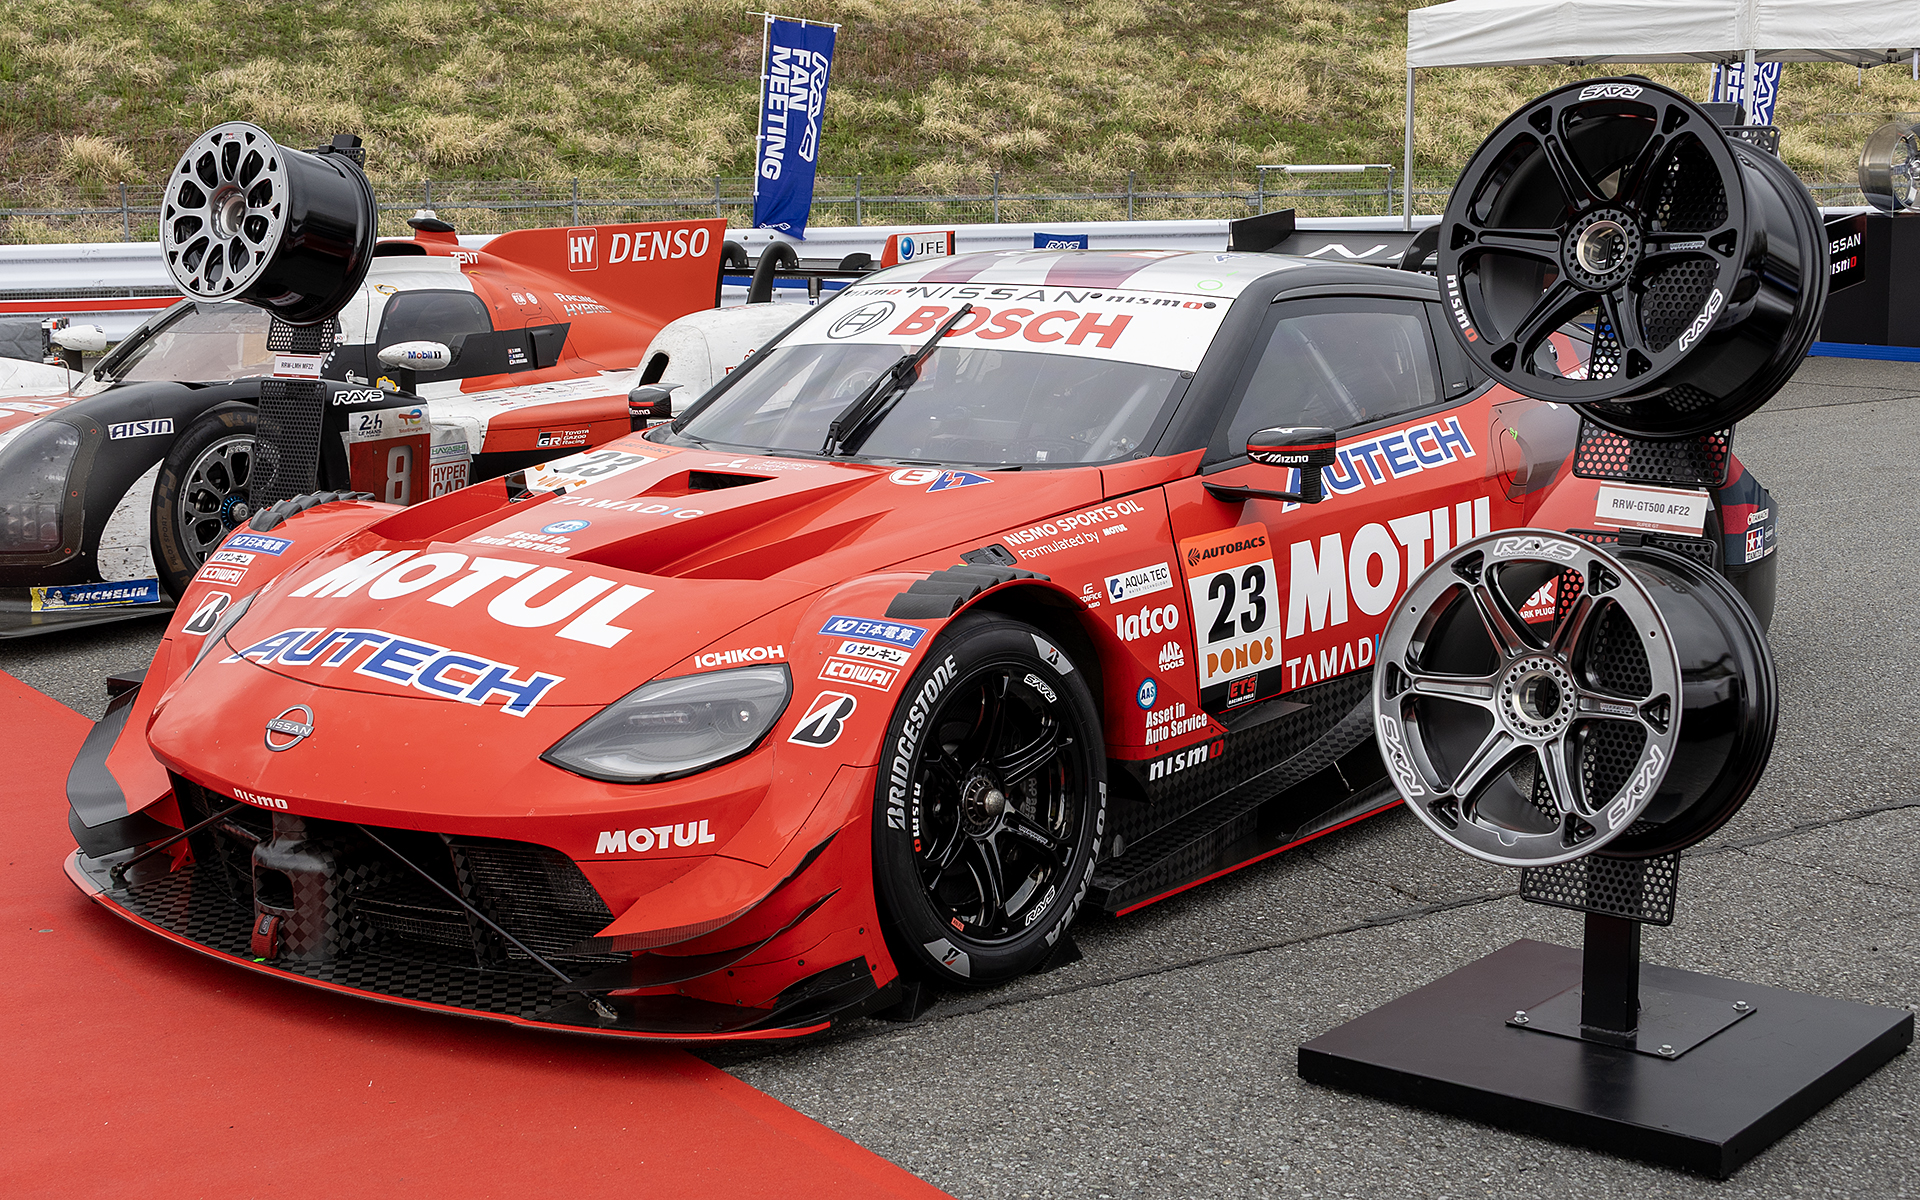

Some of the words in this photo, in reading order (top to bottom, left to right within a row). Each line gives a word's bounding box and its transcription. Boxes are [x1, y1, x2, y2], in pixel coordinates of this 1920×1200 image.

[788, 48, 812, 112] FAN
[1579, 83, 1643, 100] RAYS
[761, 45, 792, 181] MEETING
[799, 51, 829, 163] RAYS
[569, 236, 596, 264] HY
[608, 227, 710, 264] DENSO
[916, 241, 945, 256] JFE
[1830, 232, 1861, 255] ISSAN
[450, 252, 479, 264] ZENT
[907, 286, 1091, 304] NISSAN
[1105, 295, 1203, 310] nismo
[1446, 274, 1479, 343] nismo
[888, 305, 1134, 350] BOSCH
[1678, 288, 1723, 352] RAYS
[407, 351, 433, 360] Mobil
[333, 389, 385, 406] RAYS
[431, 444, 466, 455] HAYASHI
[538, 437, 562, 446] GR
[384, 444, 413, 507] 8
[432, 463, 466, 483] HYPER
[558, 451, 645, 477] 23
[552, 495, 704, 519] TAMADIC
[1612, 498, 1665, 514] RRW-GT500
[1667, 505, 1690, 516] AF22
[162, 515, 173, 540] SPORT
[1002, 523, 1059, 547] NISMO
[1056, 505, 1119, 533] SPORTS
[1116, 499, 1145, 515] OIL
[504, 531, 551, 542] Asset
[507, 539, 571, 554] Service
[1018, 533, 1085, 560] Formulated
[1084, 530, 1100, 544] by
[1102, 523, 1128, 537] MOTUL
[1202, 536, 1266, 560] AUTOBACS
[1493, 536, 1580, 560] RAYS
[164, 541, 178, 566] PILOT
[1125, 572, 1150, 589] AQUA
[1149, 567, 1168, 581] TEC
[1142, 580, 1168, 591] TECHNOLOGY
[68, 587, 149, 602] MICHELIN
[288, 549, 655, 648] MOTUL
[1207, 564, 1267, 645] 23
[1520, 609, 1535, 619] ARK
[854, 621, 916, 642] 日本電算
[694, 644, 785, 669] ICHIKOH
[857, 644, 904, 662] サンキン
[1158, 641, 1184, 664] MAC
[1206, 636, 1274, 679] PONOS
[1286, 633, 1380, 689] TAMADI
[219, 627, 566, 718] AUTECH
[824, 661, 892, 686] KOIWAI
[1159, 659, 1185, 673] TOOLS
[1024, 673, 1057, 704] RAYS
[1140, 686, 1155, 700] AAS
[1230, 676, 1256, 698] ETS
[267, 719, 311, 735] NISSAN
[1145, 705, 1174, 728] Asset
[1175, 702, 1185, 719] in
[1145, 725, 1169, 746] Auto
[1170, 712, 1208, 738] Service
[887, 654, 959, 831] BRIDGESTONE
[1379, 713, 1425, 797] RAYS
[1149, 739, 1224, 782] nismo
[233, 787, 288, 810] nismo
[1607, 744, 1666, 829] RAYS
[911, 782, 922, 853] nismo
[595, 819, 716, 854] MOTUL
[1045, 781, 1107, 947] POTENZA
[1025, 885, 1056, 927] RAYS
